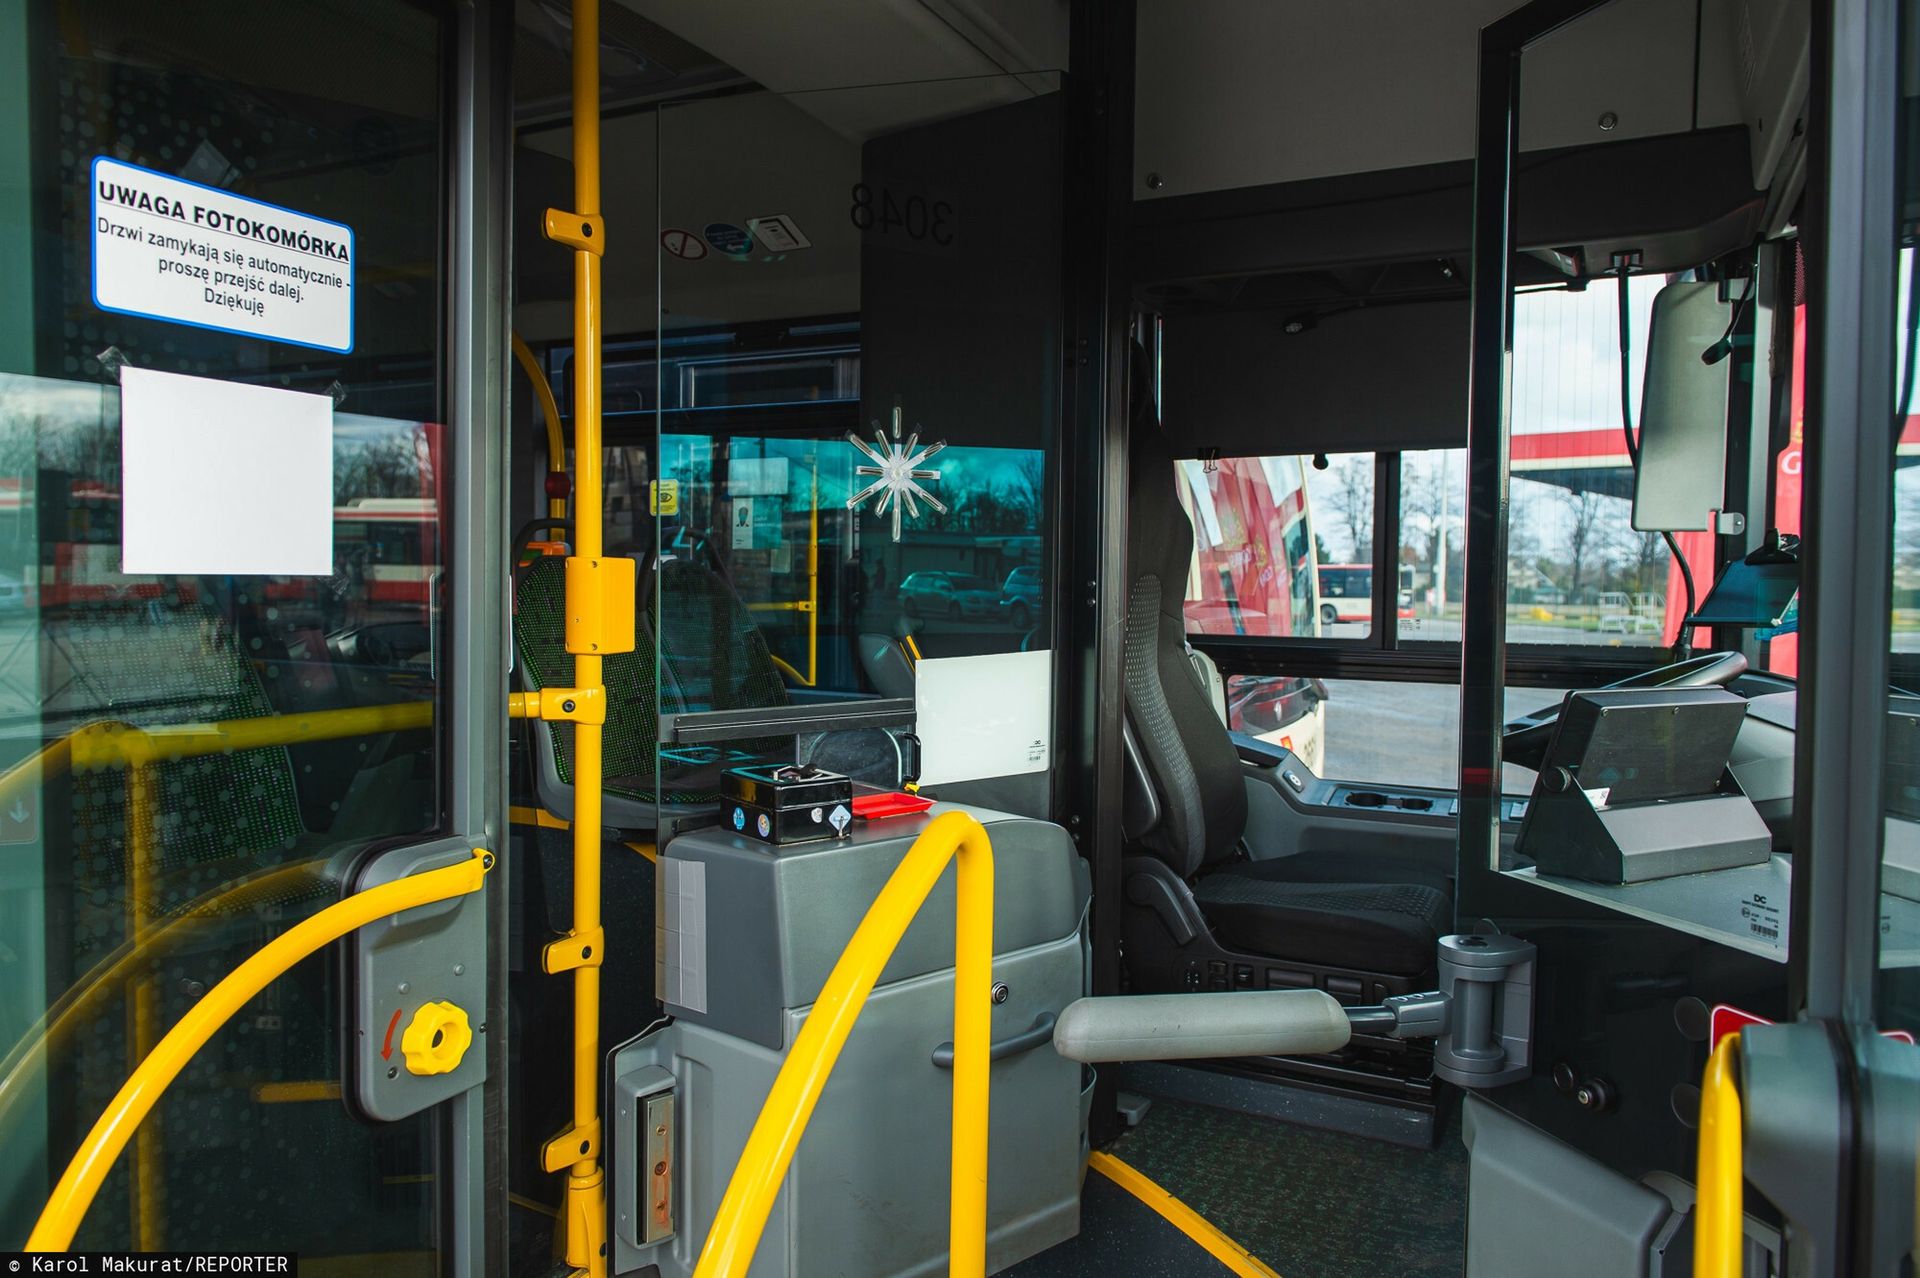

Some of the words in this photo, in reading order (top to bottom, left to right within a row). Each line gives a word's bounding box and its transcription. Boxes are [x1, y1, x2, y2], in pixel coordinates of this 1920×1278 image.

[99, 181, 186, 220] UWAGA
[194, 206, 349, 262] FOTOKOMÓRKA
[98, 217, 143, 243] Drzwi
[148, 232, 220, 264] zamykają
[223, 248, 244, 270] się
[248, 255, 343, 289] automatycznie
[158, 257, 210, 284] proszę
[214, 269, 265, 293] przejść
[269, 279, 305, 303] dalej.
[204, 287, 264, 318] Dziękuję
[1754, 894, 1767, 904] DC
